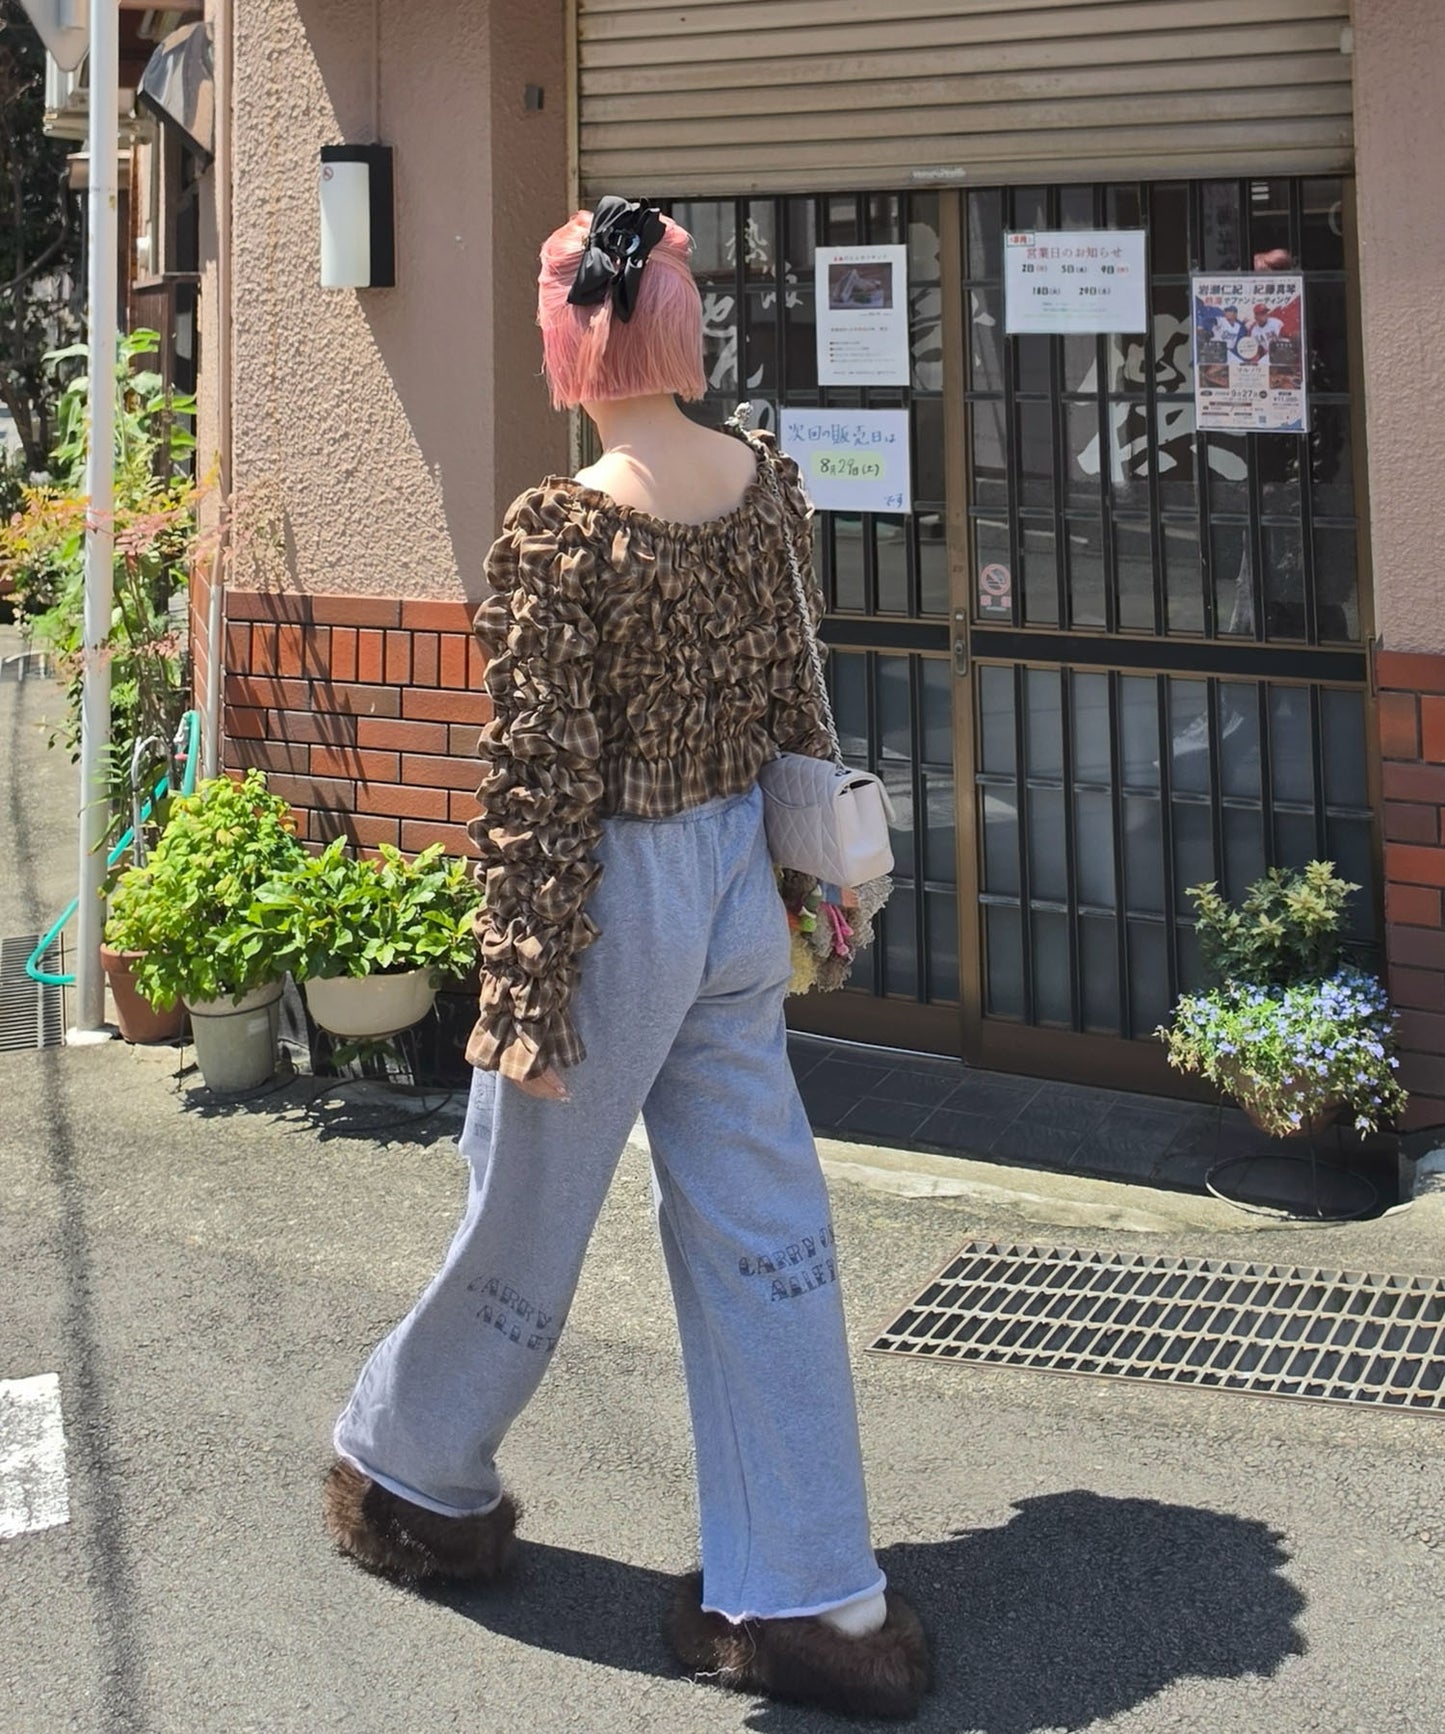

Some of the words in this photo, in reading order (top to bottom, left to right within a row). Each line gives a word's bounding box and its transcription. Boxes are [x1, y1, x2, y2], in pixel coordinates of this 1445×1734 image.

[1026, 246, 1122, 260] 営業日のお知らせ
[788, 423, 896, 446] 次回の販売日は
[819, 458, 881, 477] 8月29日(土)
